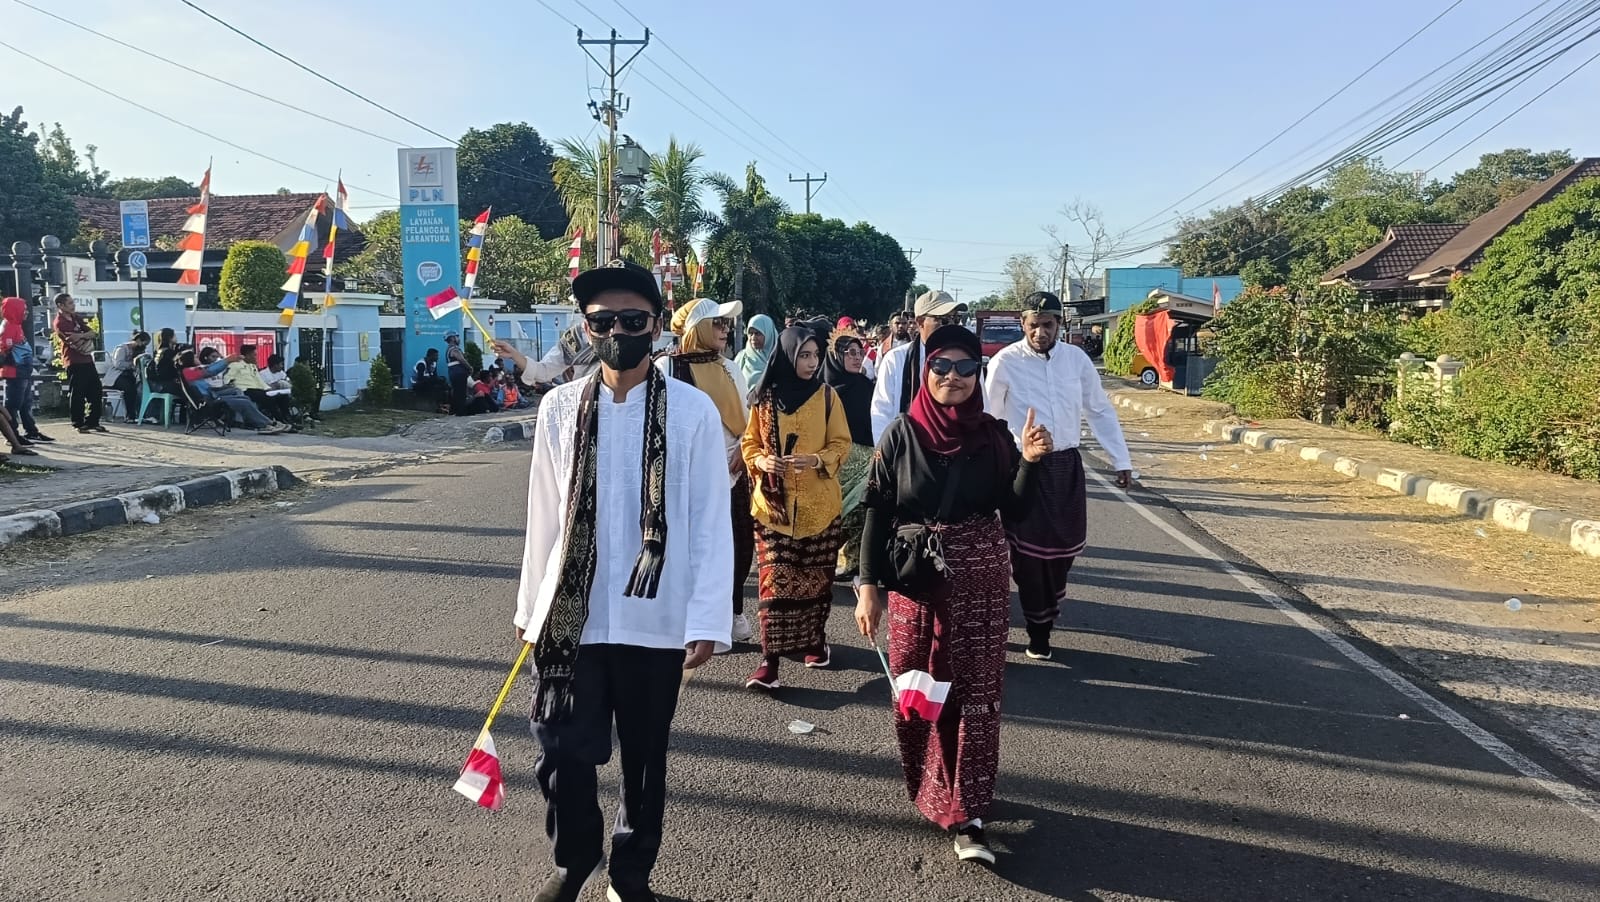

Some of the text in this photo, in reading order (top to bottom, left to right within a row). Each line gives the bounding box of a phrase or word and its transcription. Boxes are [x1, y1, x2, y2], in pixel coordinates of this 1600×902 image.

[409, 189, 444, 201] PLN
[417, 208, 435, 217] UNIT
[409, 217, 443, 226] LAYANAN
[406, 226, 450, 235] PELANGGAN
[406, 234, 450, 243] LARANTUKA
